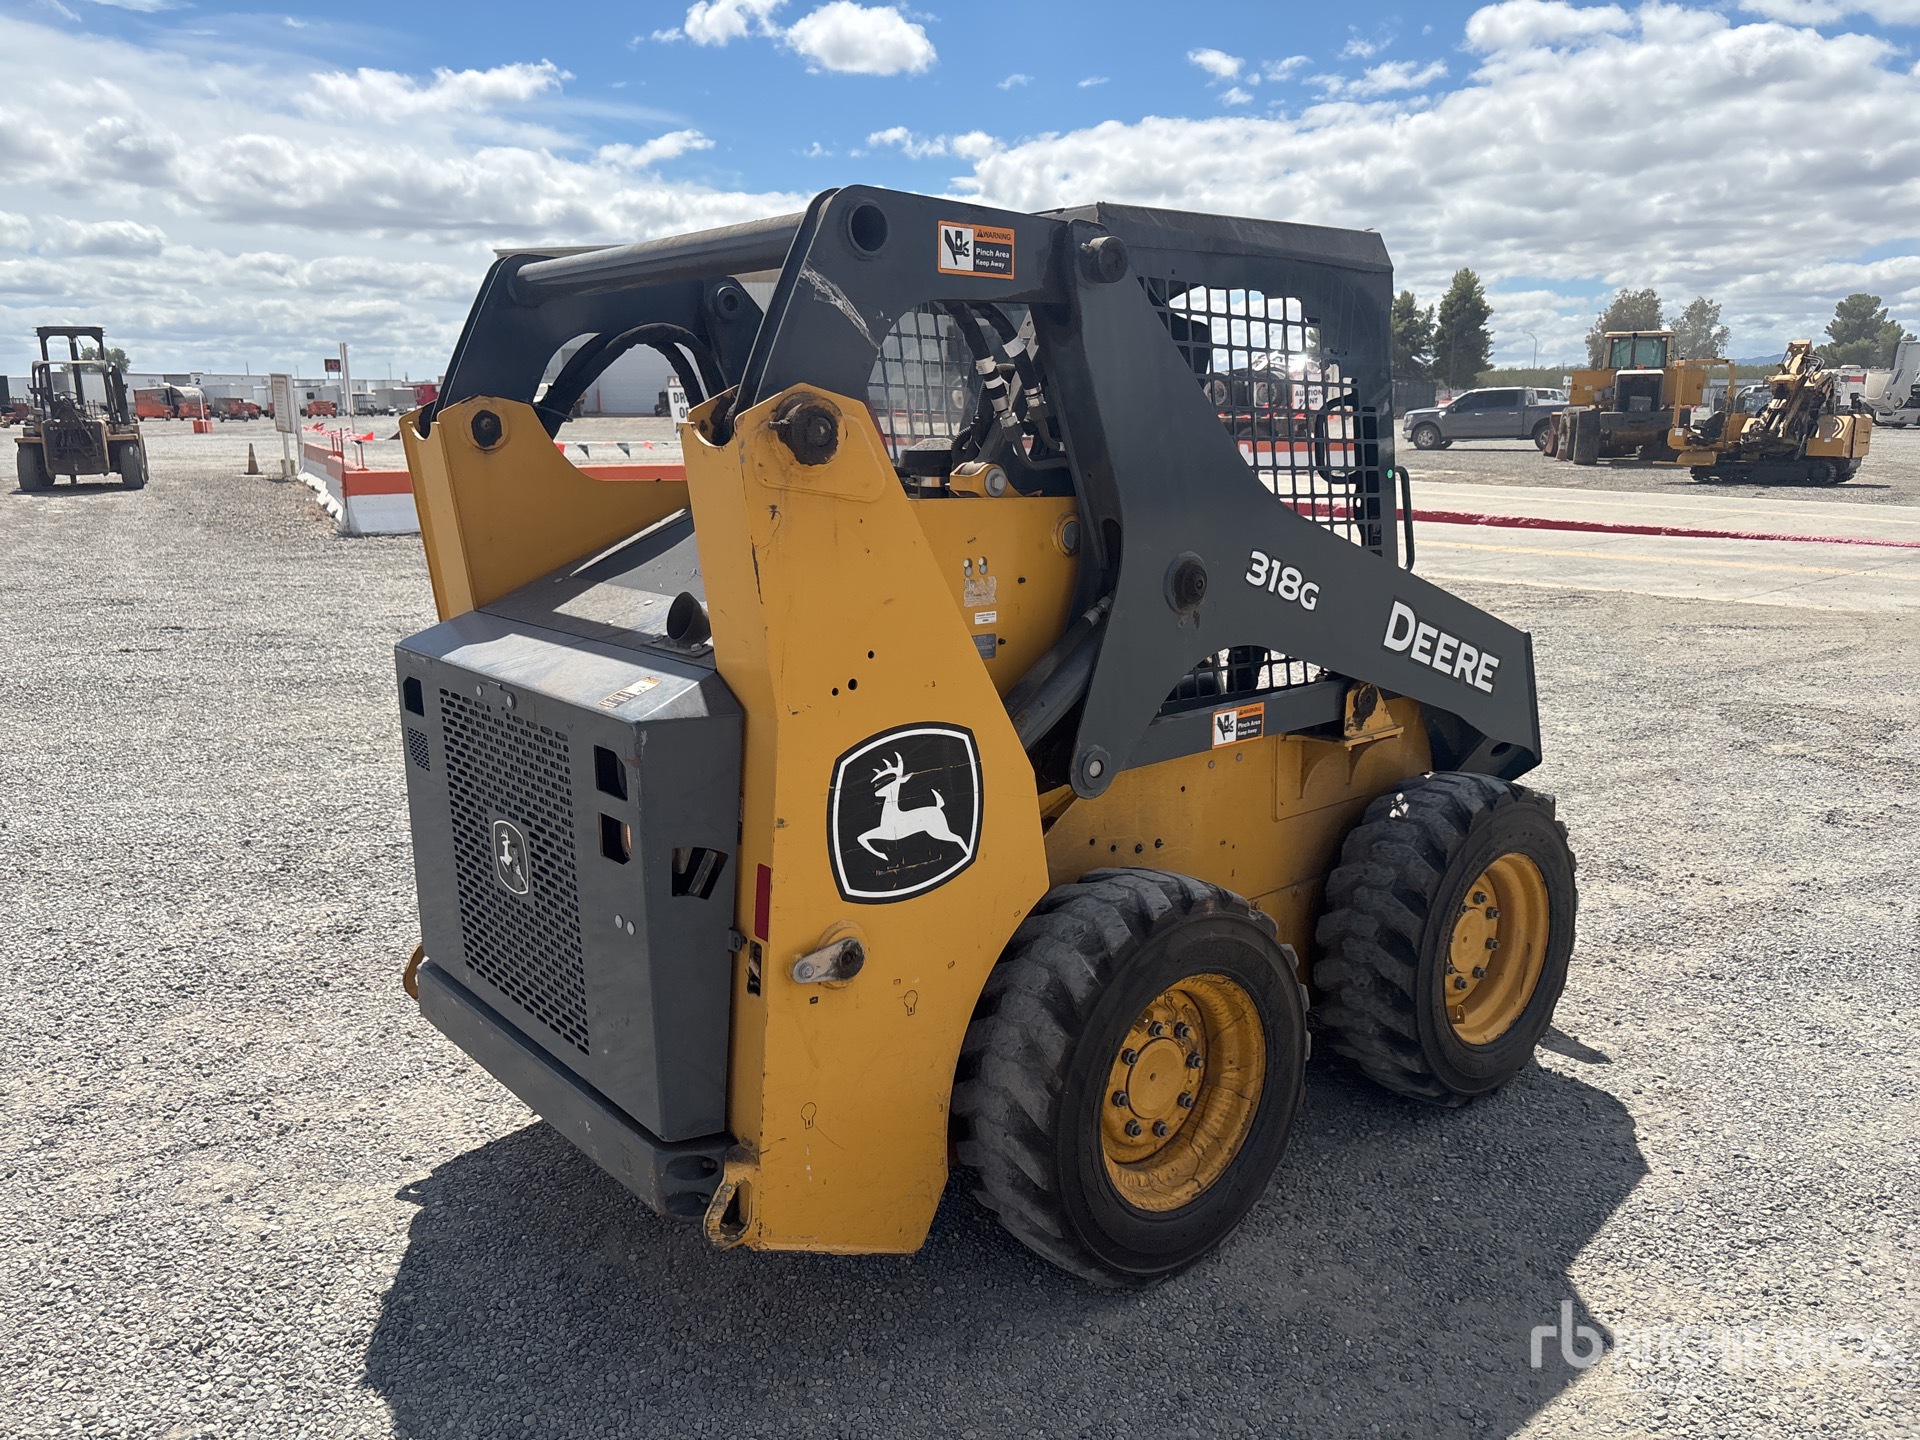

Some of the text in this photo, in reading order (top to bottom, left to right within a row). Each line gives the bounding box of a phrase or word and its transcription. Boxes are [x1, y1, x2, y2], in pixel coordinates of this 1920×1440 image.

[983, 231, 1011, 240] WARNING
[976, 248, 1010, 258] Pinch Area
[976, 259, 1005, 269] Keep Away
[1245, 550, 1320, 611] 318G
[1383, 601, 1500, 693] DEERE
